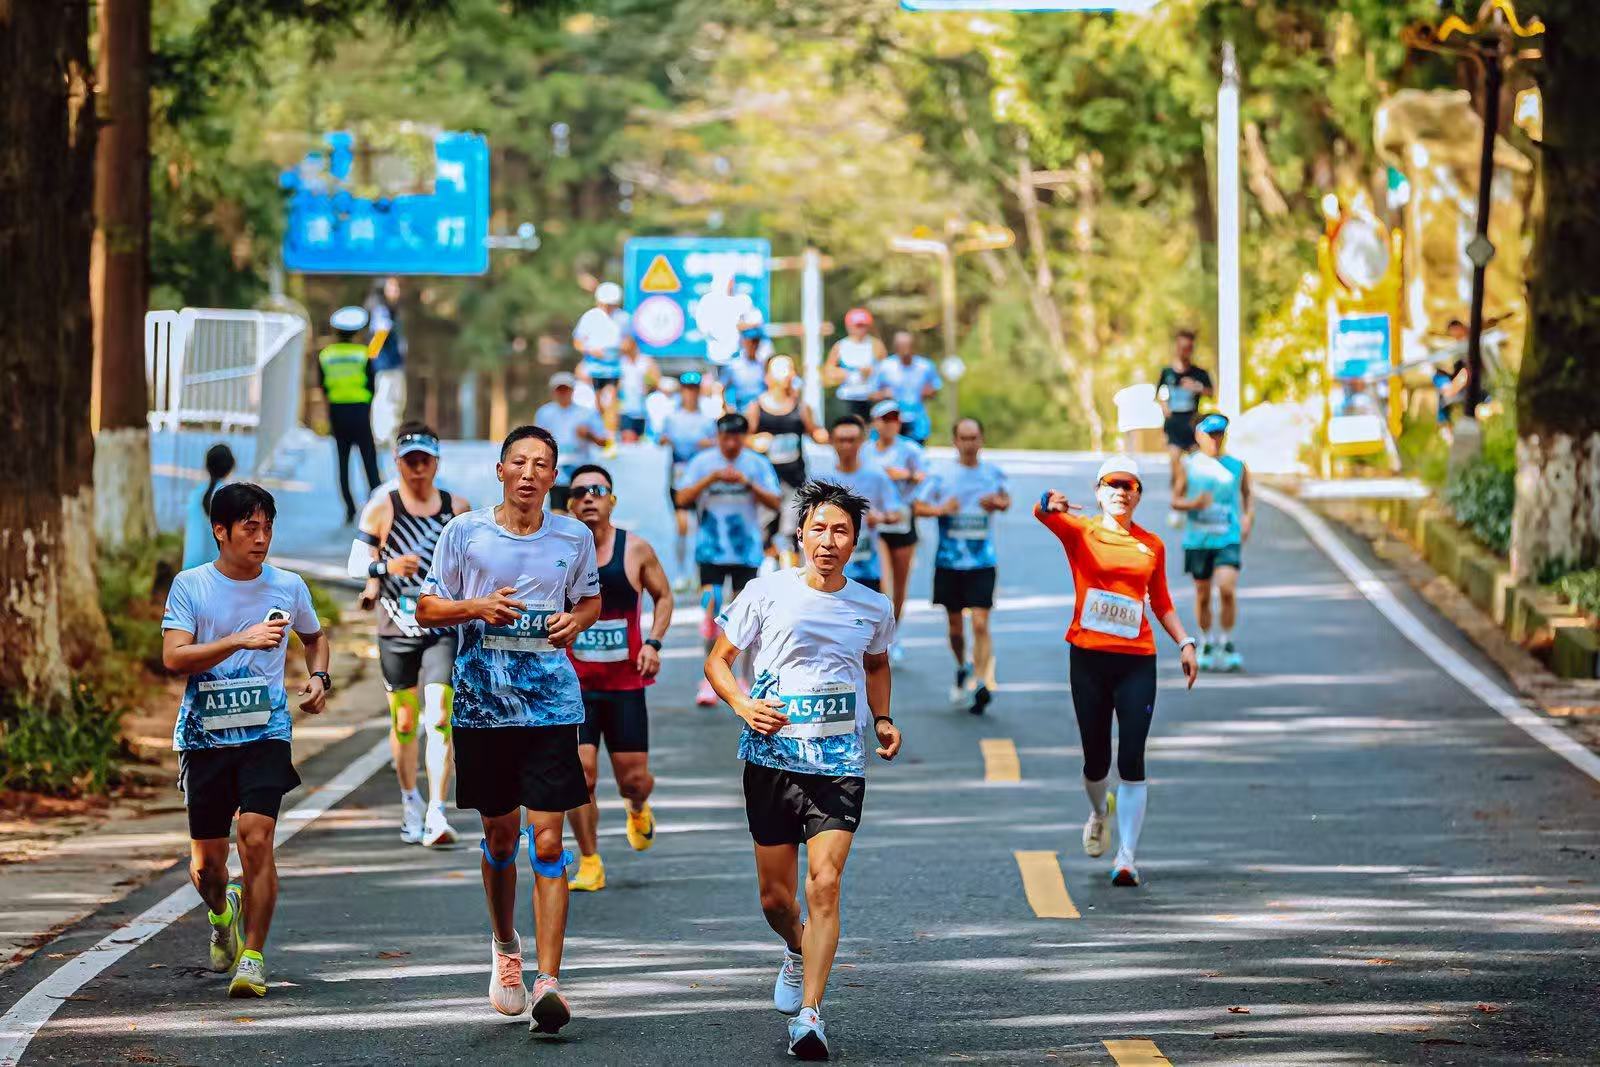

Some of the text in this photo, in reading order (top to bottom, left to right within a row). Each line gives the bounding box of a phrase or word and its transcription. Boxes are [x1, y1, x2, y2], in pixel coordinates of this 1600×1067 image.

[1090, 601, 1137, 622] A9088
[205, 690, 262, 710] A1107
[787, 698, 849, 716] A5421
